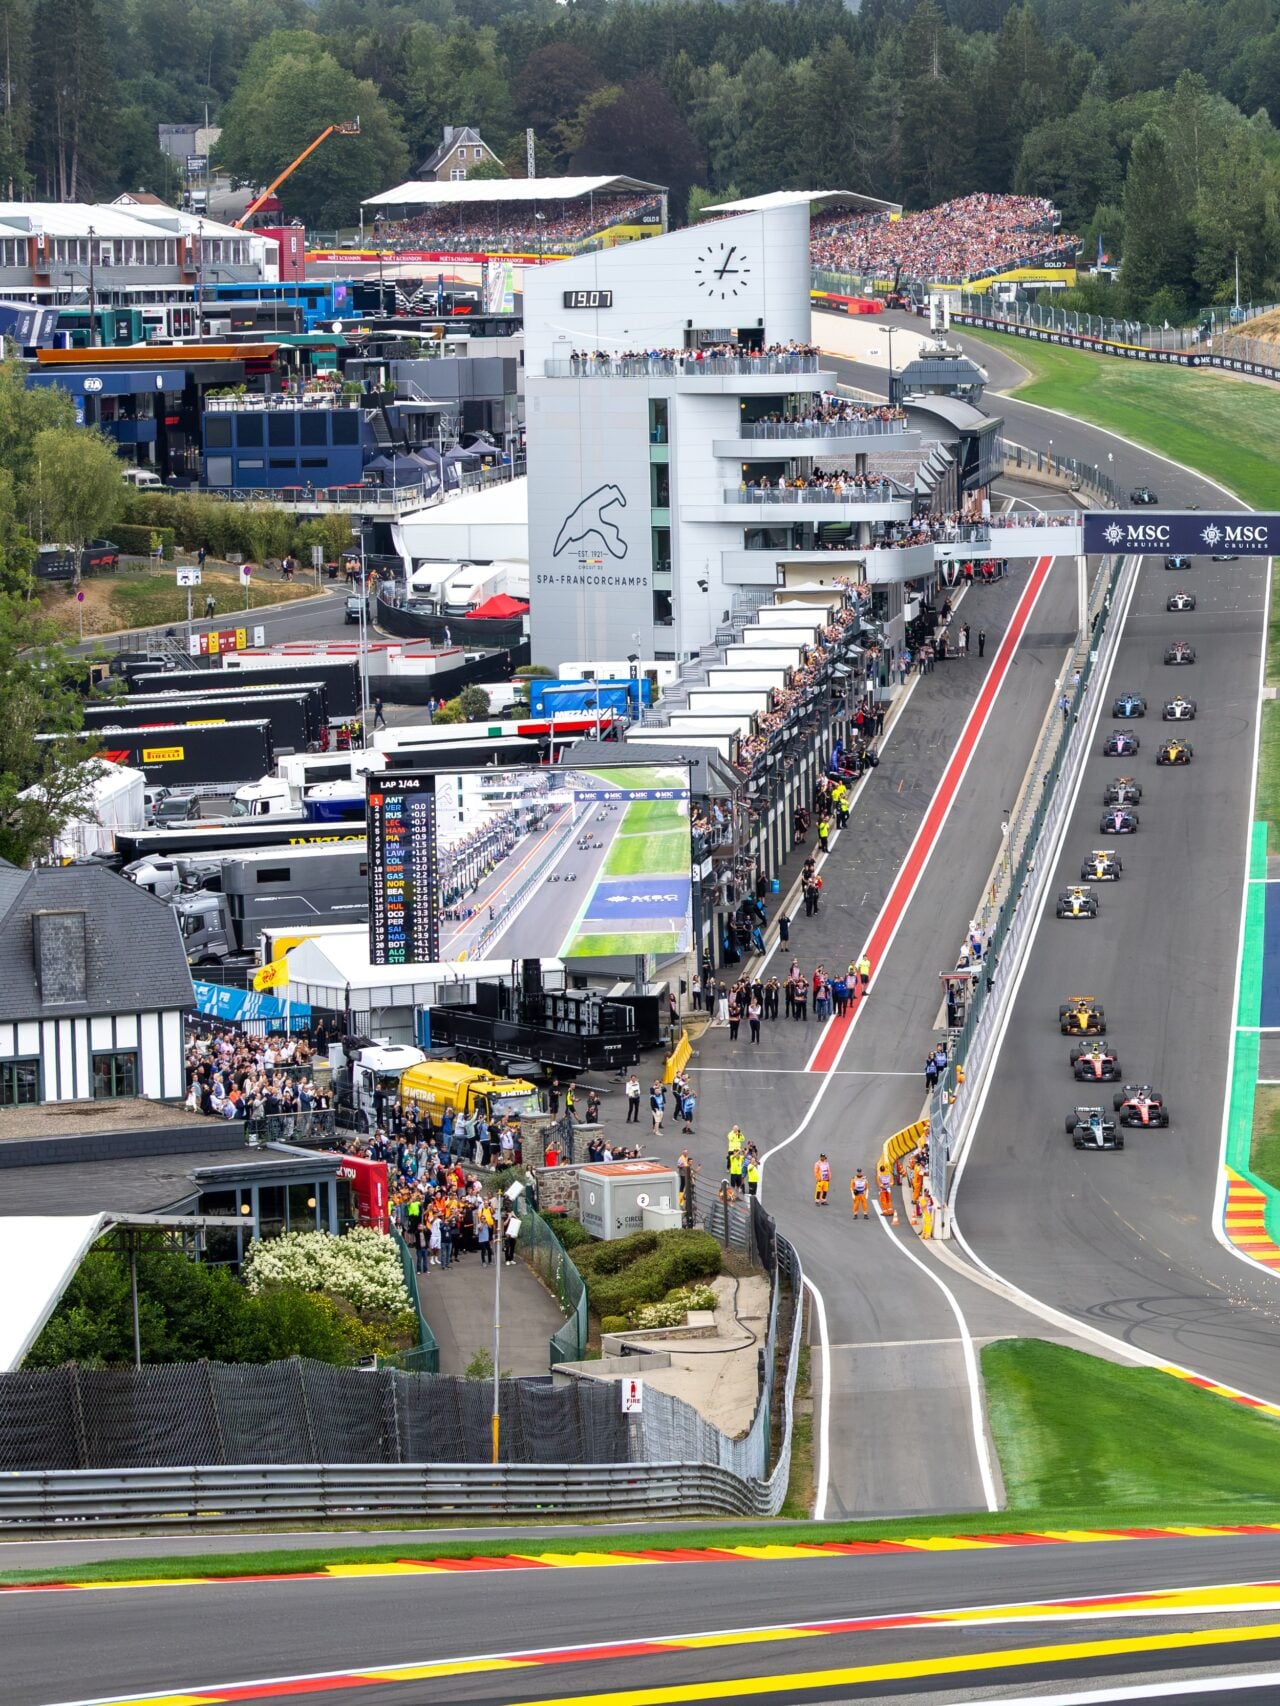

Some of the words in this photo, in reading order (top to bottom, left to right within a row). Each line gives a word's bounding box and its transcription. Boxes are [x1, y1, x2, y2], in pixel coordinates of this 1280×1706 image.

[572, 292, 611, 306] 19.07
[86, 378, 101, 390] FIA
[1127, 525, 1170, 540] MSC
[1225, 526, 1268, 540] MSC
[537, 574, 648, 586] SPA-FRANCORCHAMPS
[147, 750, 180, 759] PIRELLI
[409, 1088, 436, 1102] METRAS
